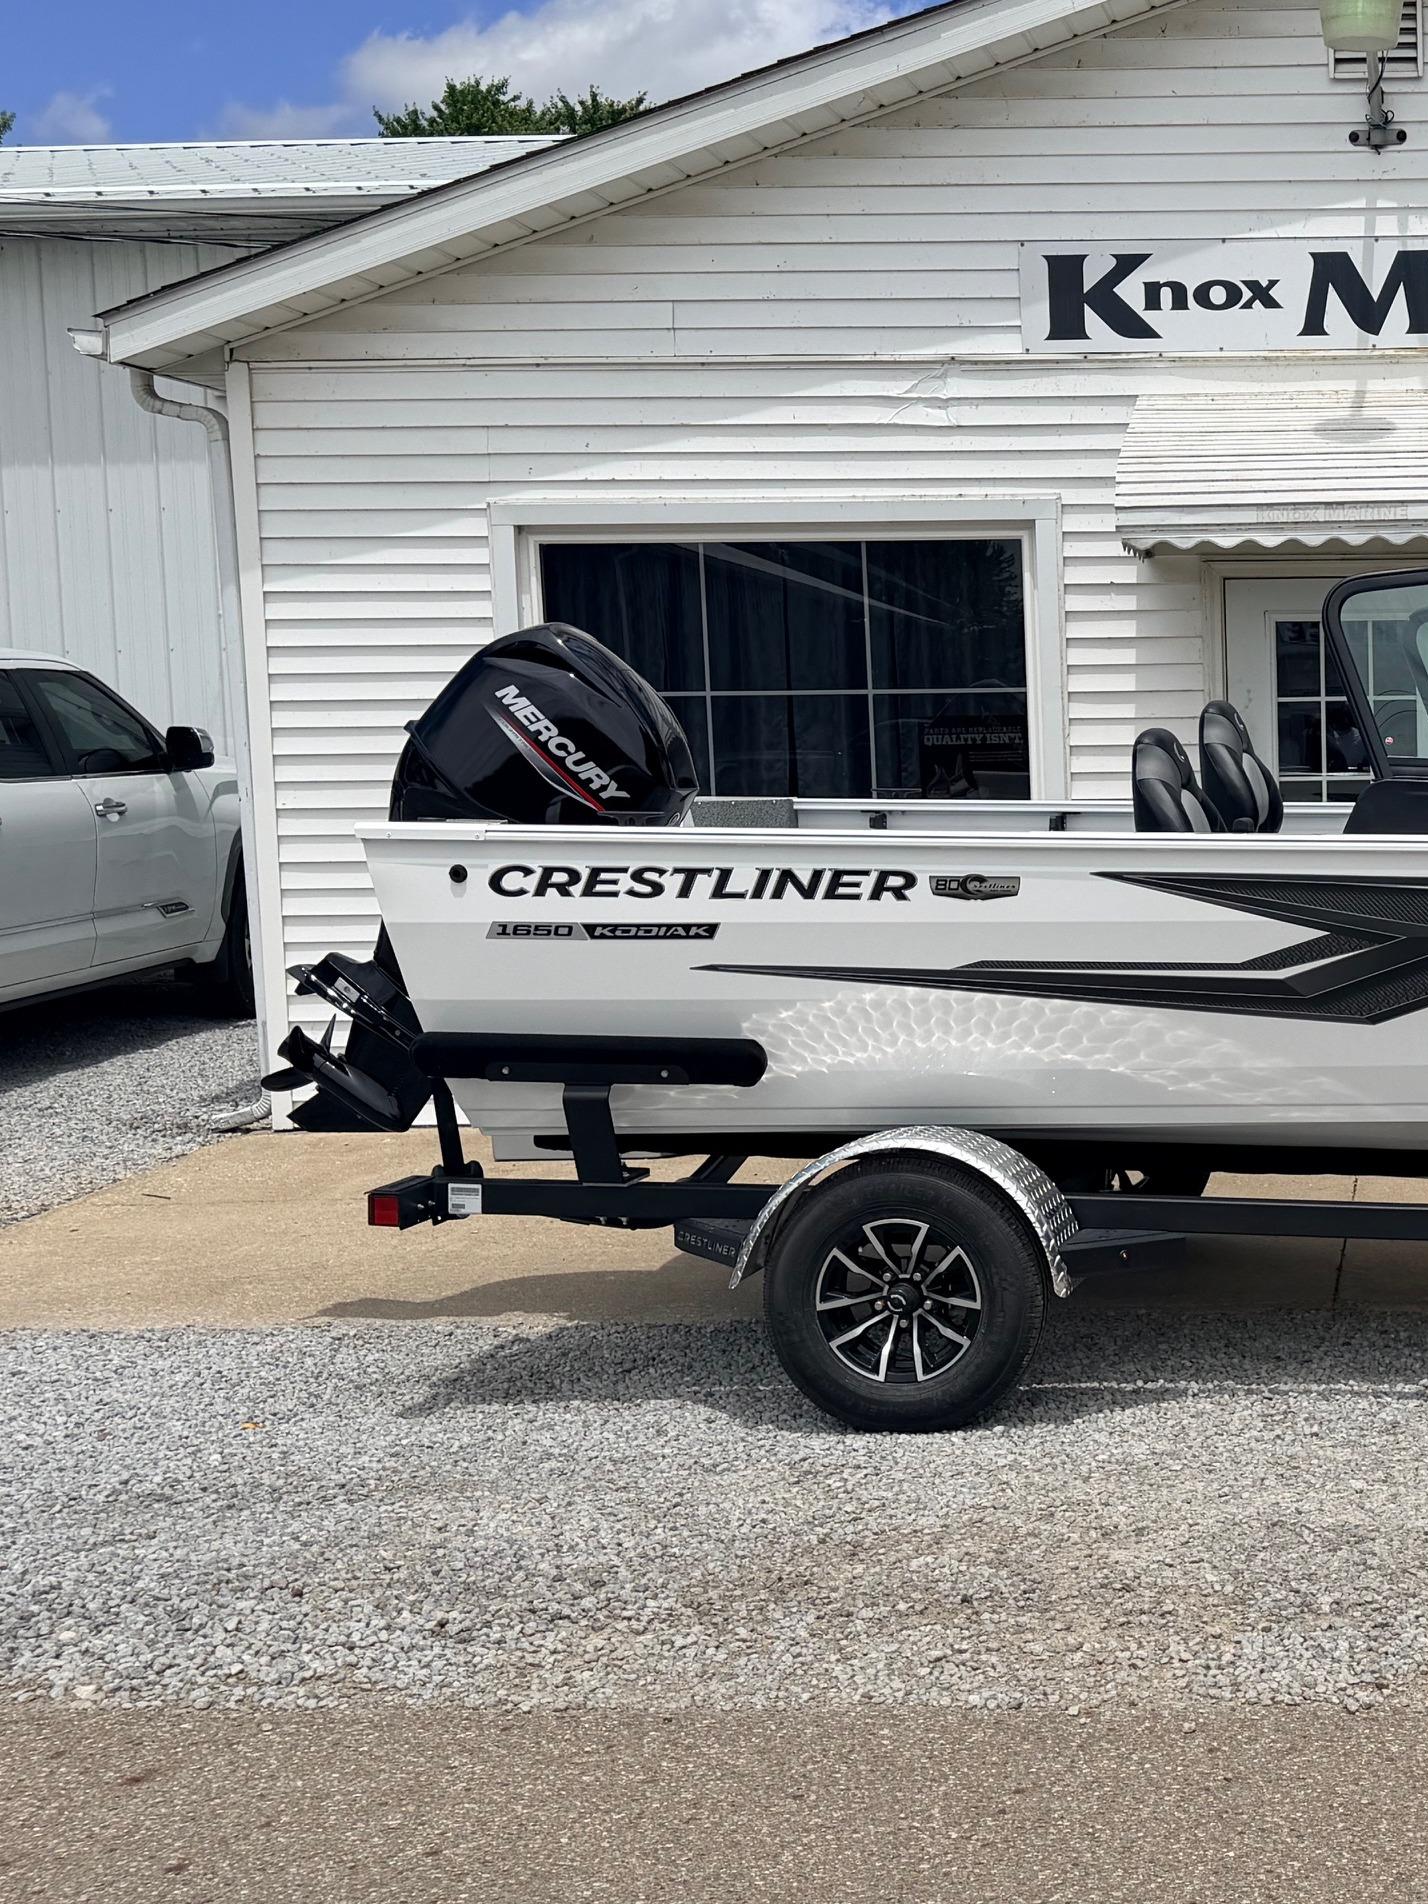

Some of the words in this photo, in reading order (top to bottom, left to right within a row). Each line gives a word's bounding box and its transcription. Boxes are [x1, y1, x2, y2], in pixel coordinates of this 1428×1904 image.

[1041, 253, 1283, 341] Knox
[494, 684, 631, 800] MERCURY
[923, 734, 982, 746] QUALITY
[488, 864, 918, 901] CRESTLINER
[496, 923, 573, 938] 1650
[594, 926, 710, 938] KODIAK
[678, 1231, 736, 1258] CRESTLINER
